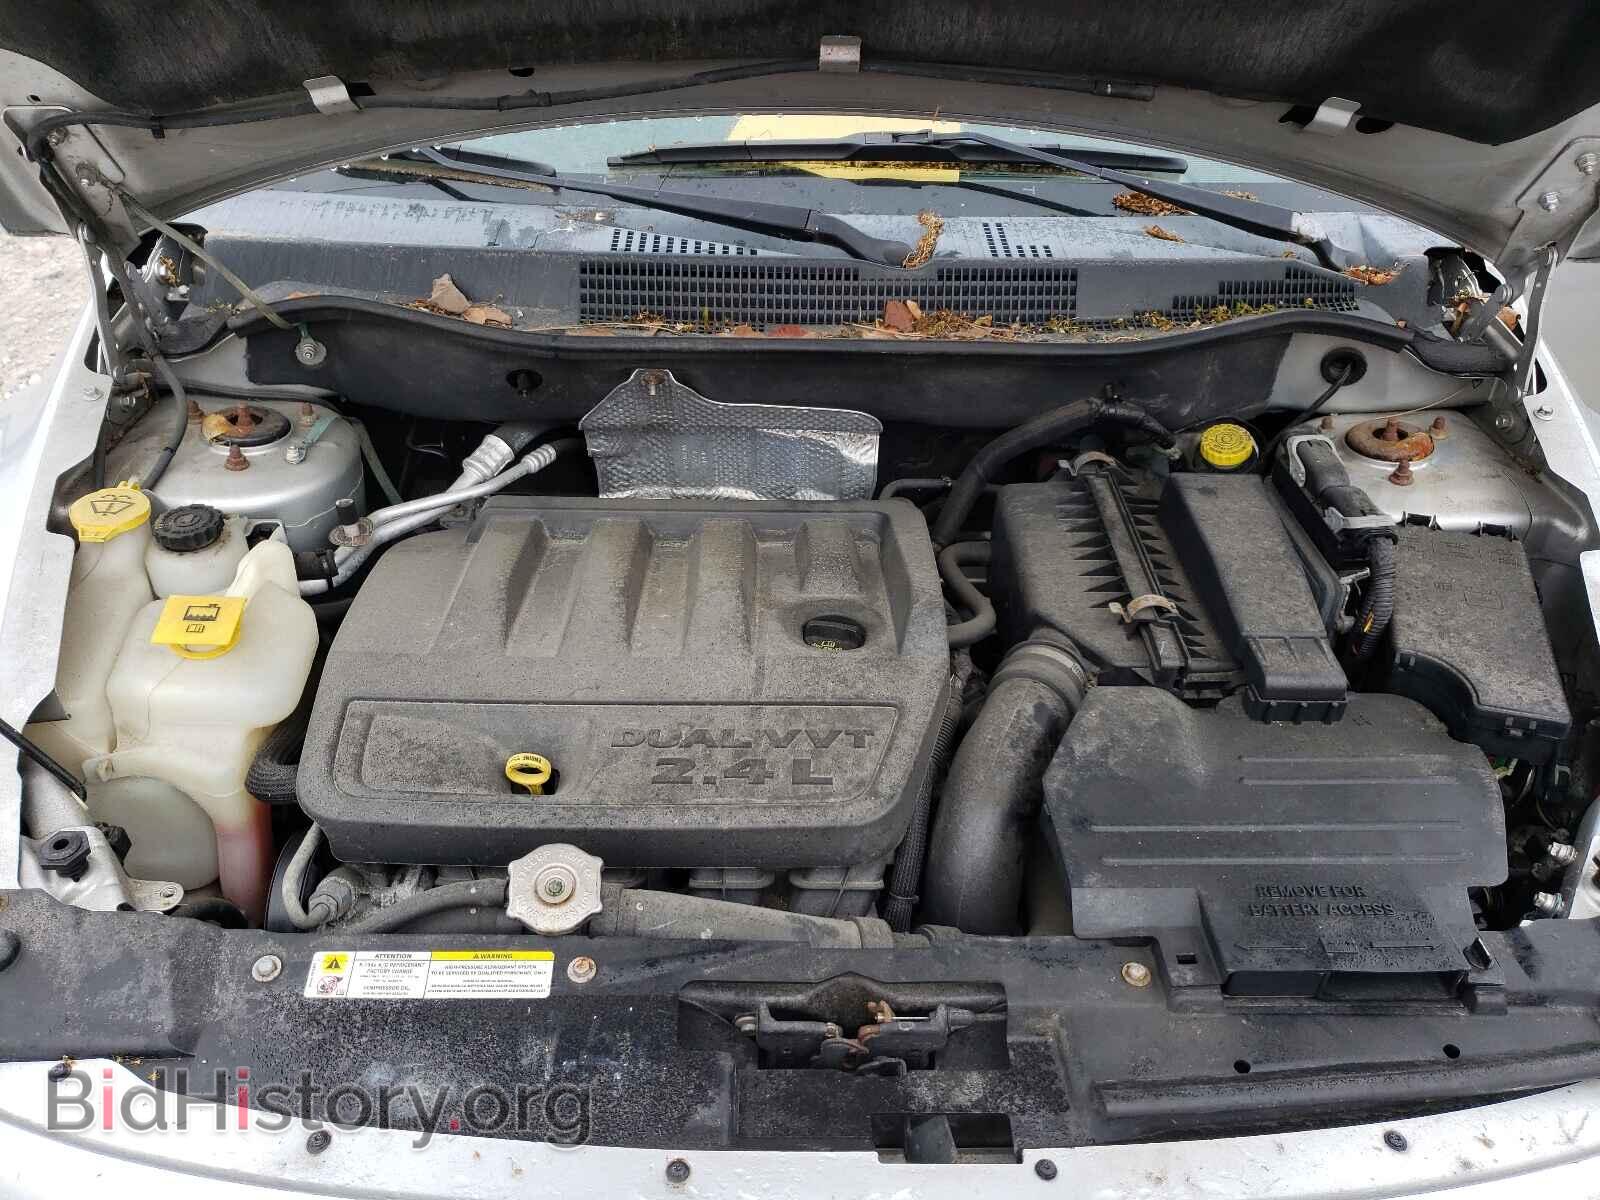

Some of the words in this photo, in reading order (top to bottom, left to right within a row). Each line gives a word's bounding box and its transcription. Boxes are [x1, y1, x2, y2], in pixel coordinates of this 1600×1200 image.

[610, 728, 752, 749] DUAL
[762, 728, 875, 749] VVT
[1255, 884, 1328, 899] REMOVE
[1329, 884, 1369, 899] FOR
[1248, 903, 1321, 918] BATTERY
[1326, 903, 1396, 917] ACCESS
